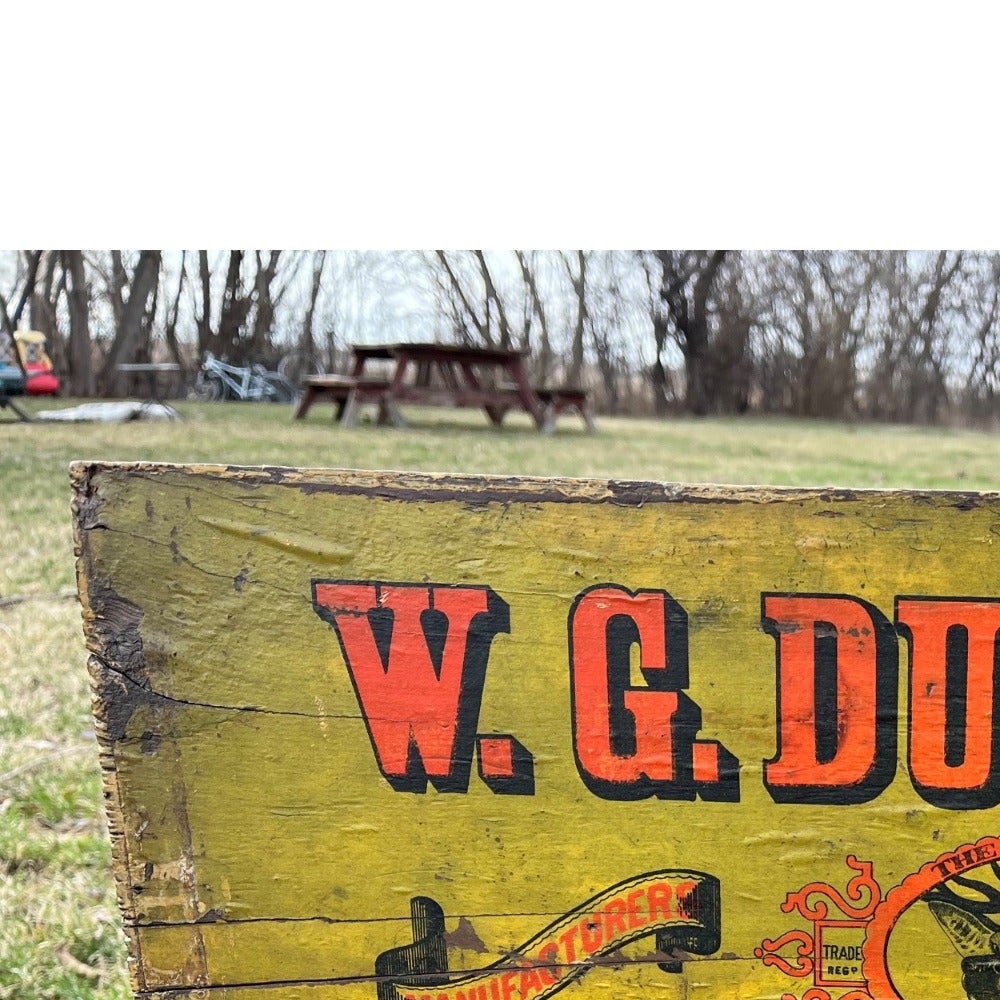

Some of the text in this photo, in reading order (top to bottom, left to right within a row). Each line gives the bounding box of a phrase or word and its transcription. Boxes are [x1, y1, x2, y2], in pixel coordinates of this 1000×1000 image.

[312, 578, 535, 795] W.
[567, 583, 741, 802] G.
[930, 842, 998, 878] THE
[823, 944, 863, 961] TRADE
